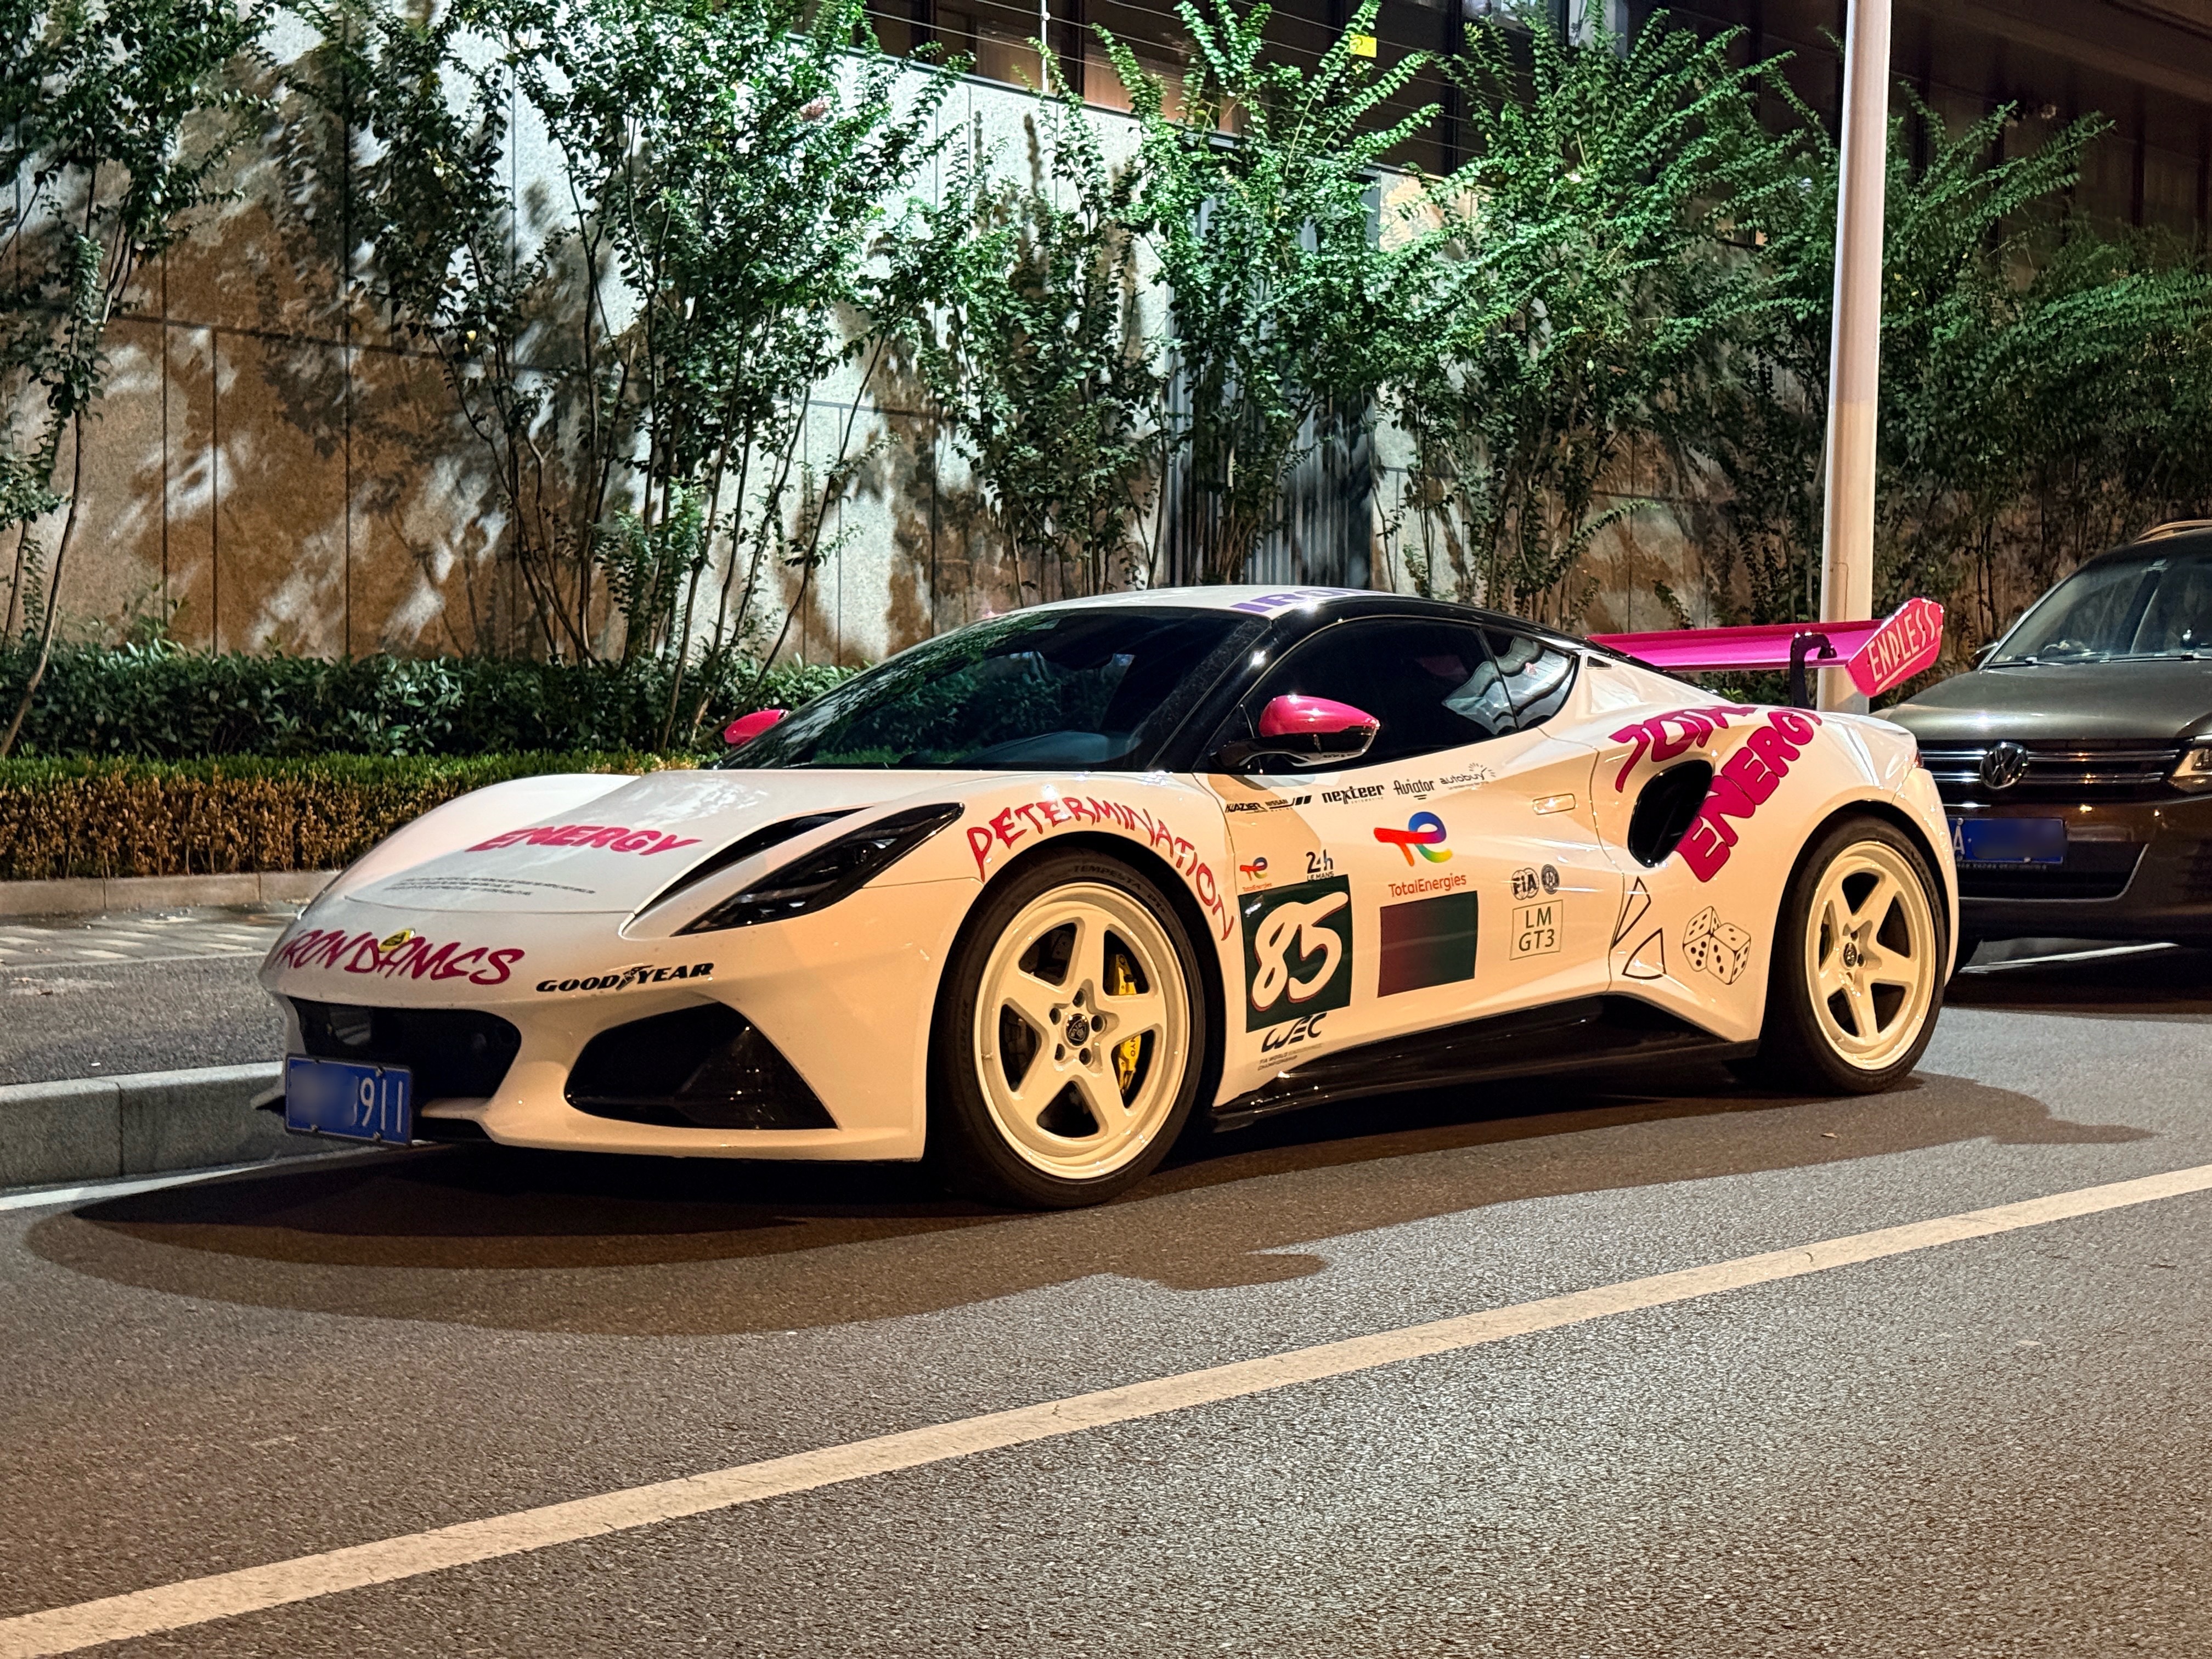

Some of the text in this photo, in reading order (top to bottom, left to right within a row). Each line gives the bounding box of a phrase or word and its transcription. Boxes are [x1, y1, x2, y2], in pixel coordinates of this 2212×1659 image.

[1867, 603, 1935, 682] ENDLESS
[1322, 786, 1385, 804] nexteer
[1393, 778, 1435, 795] Aviator
[465, 825, 703, 855] ENERGY
[1388, 872, 1467, 898] TotalEnergies
[1526, 906, 1551, 928] LM
[1251, 891, 1349, 1011] 85
[1519, 928, 1555, 951] GT3
[536, 963, 714, 992] GOODYEAR
[1261, 1012, 1327, 1053] WEC
[354, 1077, 403, 1133] 911
